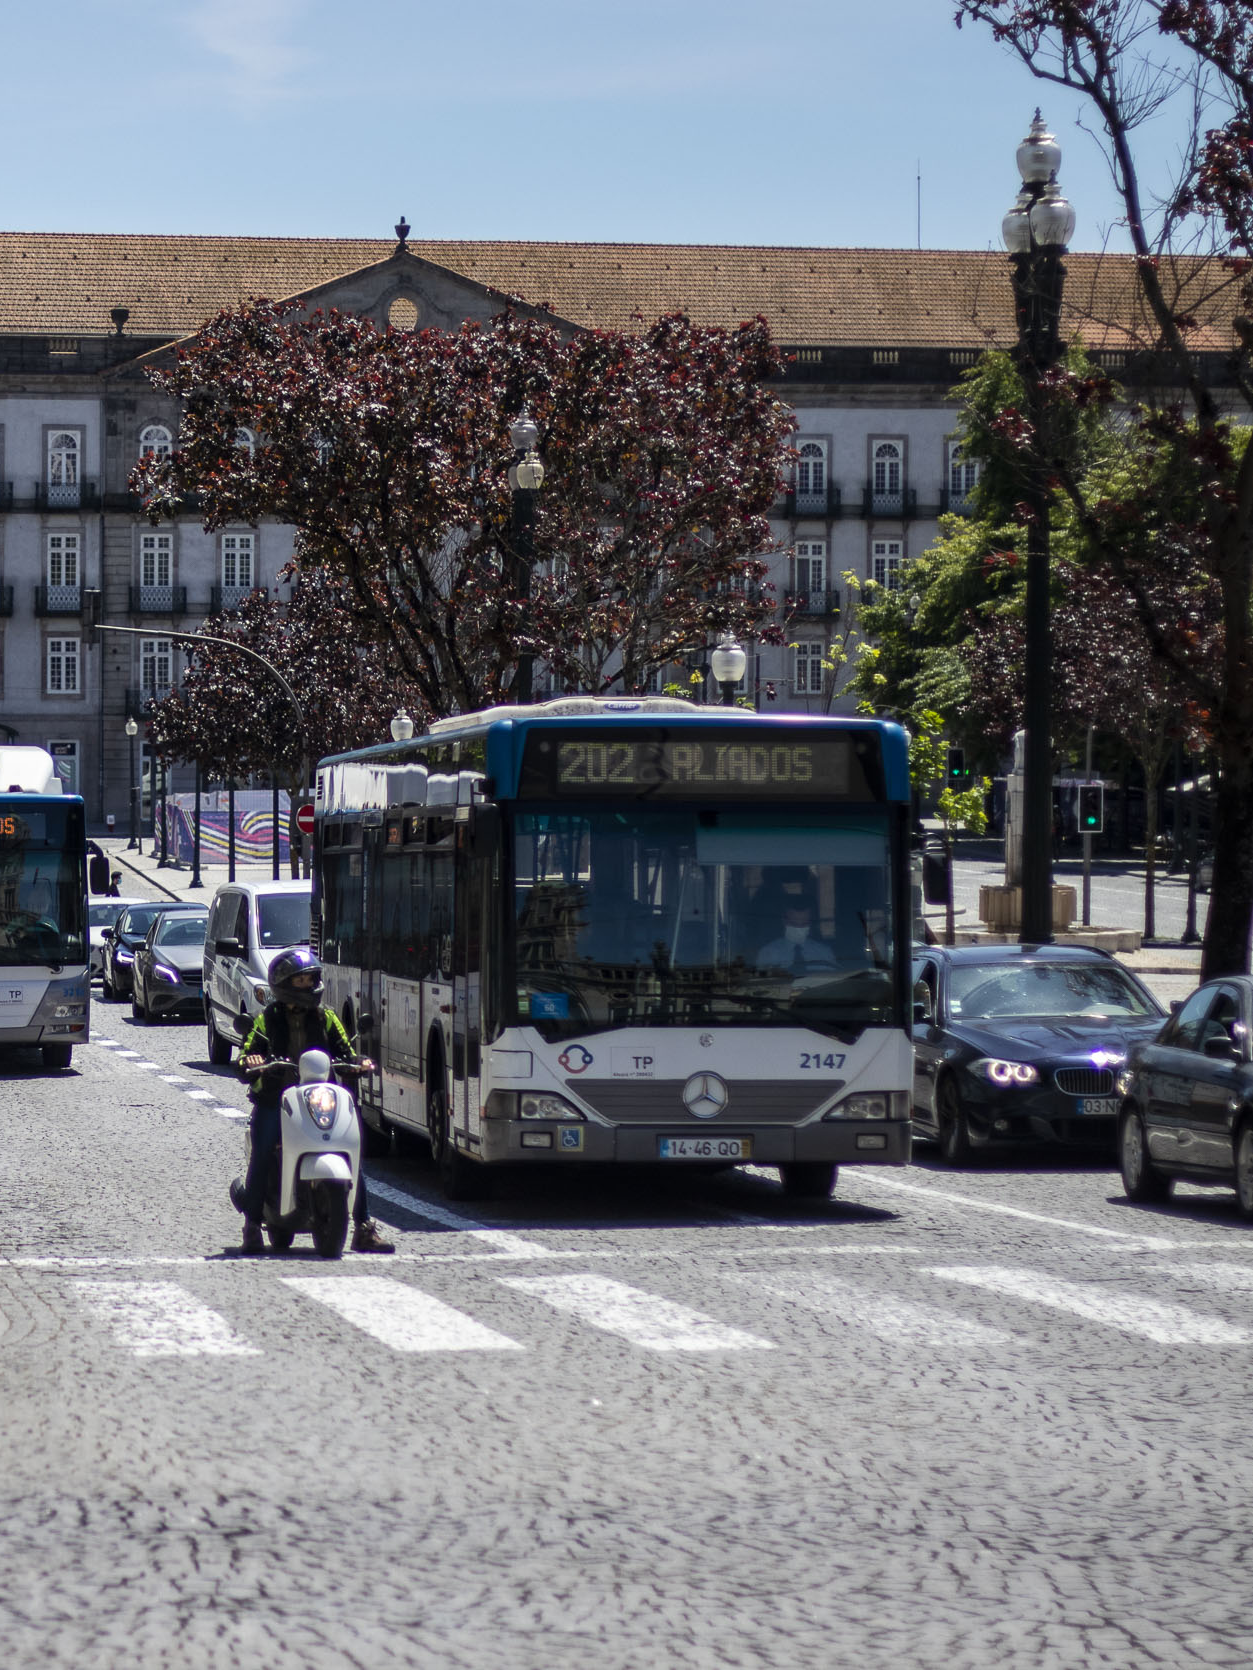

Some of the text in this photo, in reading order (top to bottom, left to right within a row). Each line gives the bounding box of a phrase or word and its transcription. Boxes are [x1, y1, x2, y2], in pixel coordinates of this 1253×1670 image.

[558, 742, 813, 784] 202 ALIADOS
[9, 990, 22, 999] TP
[632, 1056, 654, 1070] TP
[799, 1052, 847, 1069] 2147
